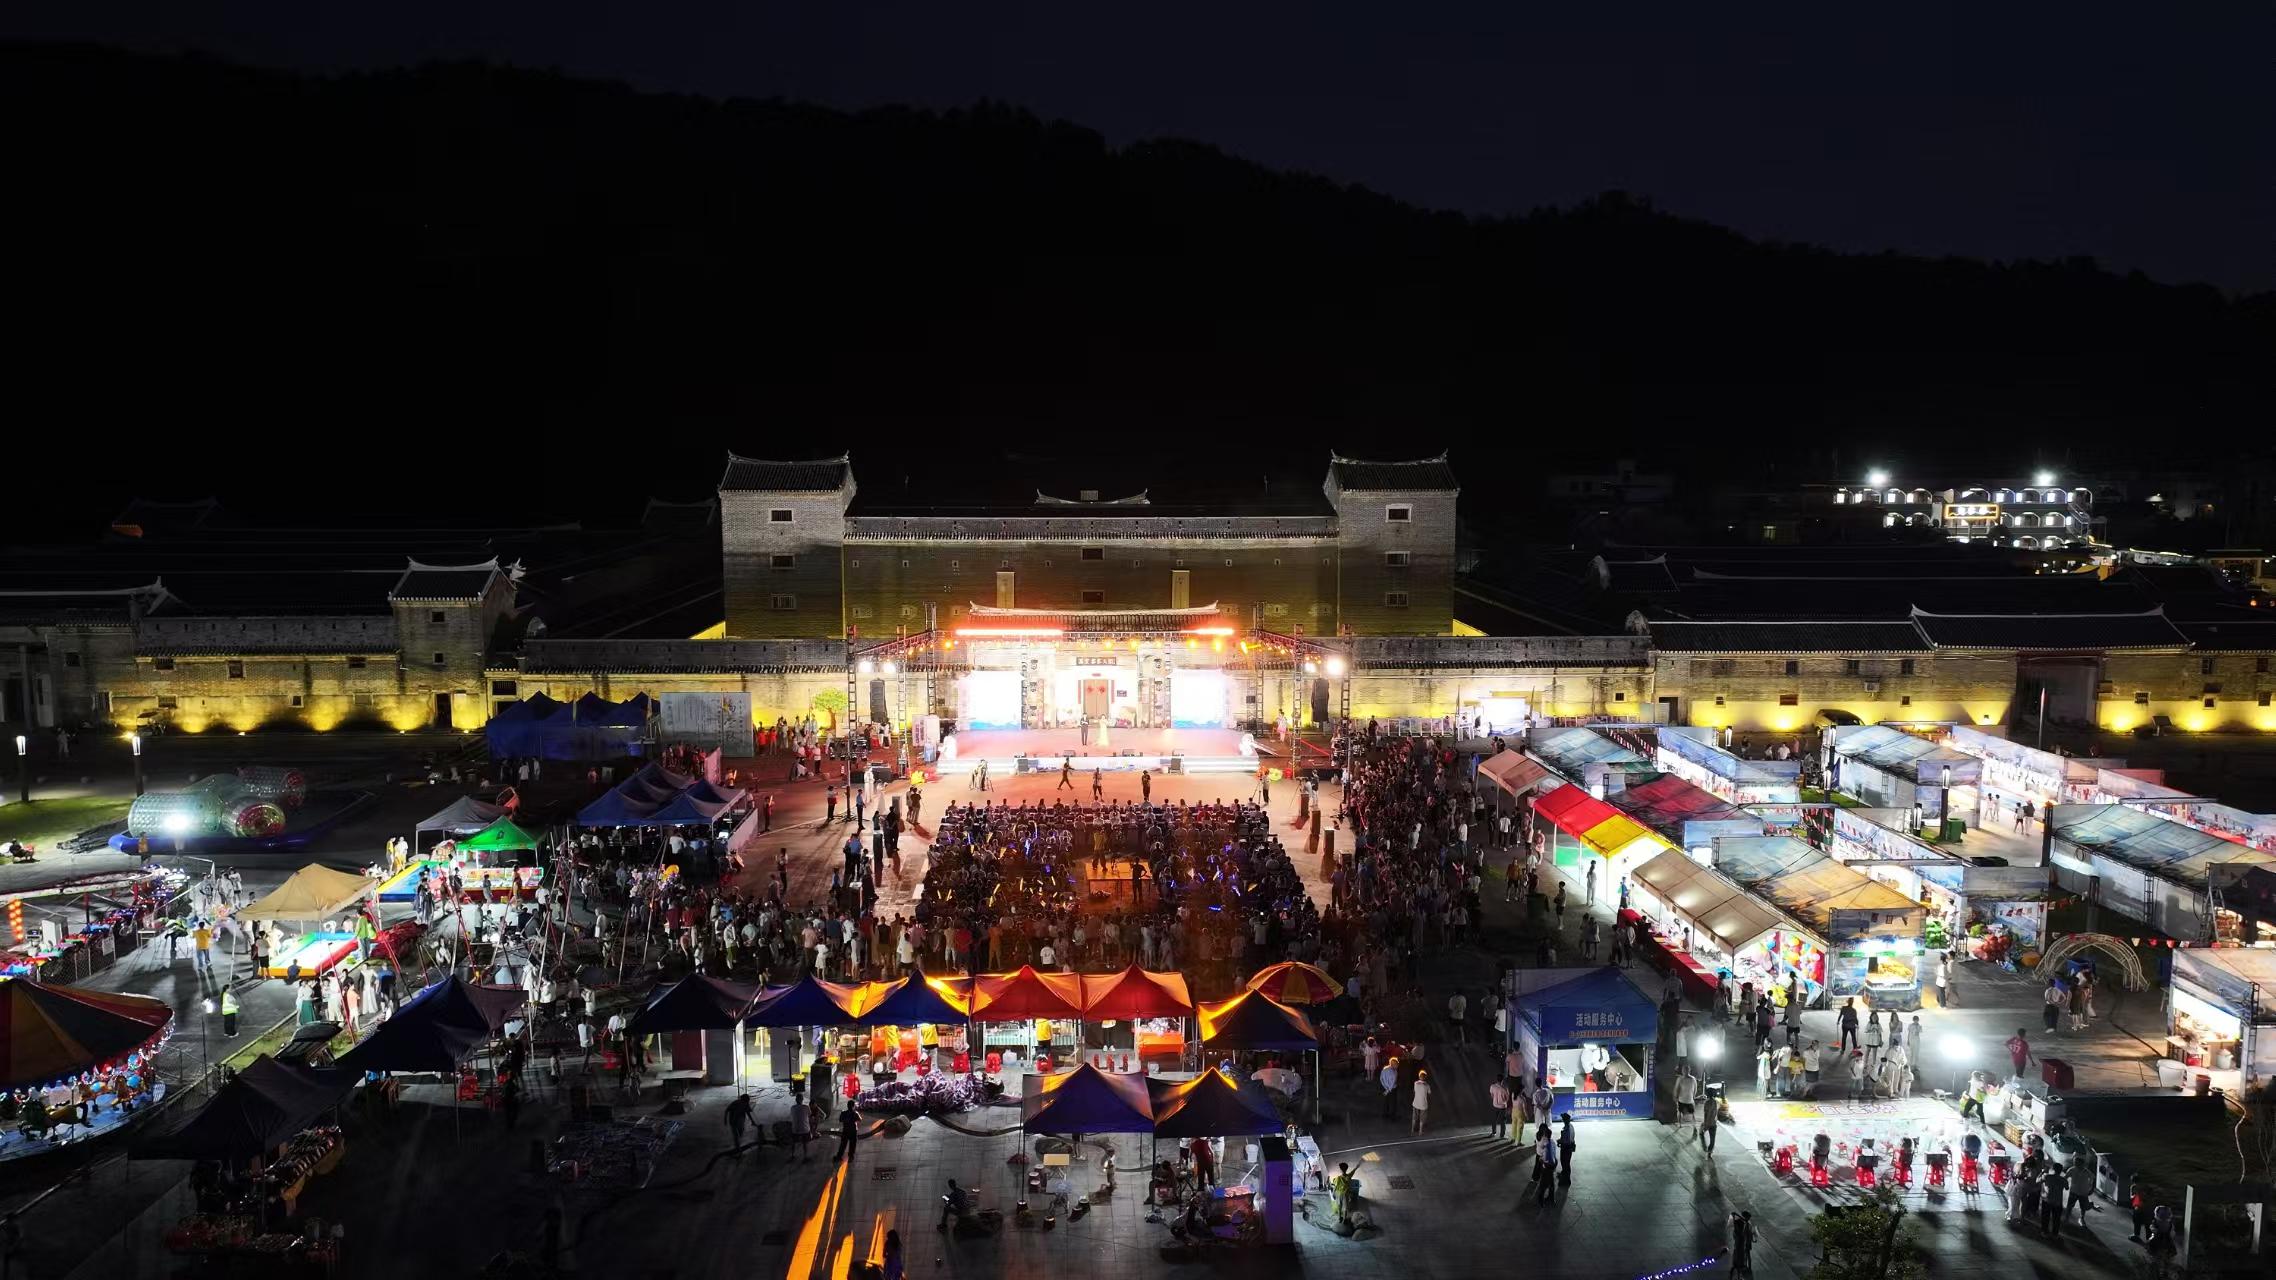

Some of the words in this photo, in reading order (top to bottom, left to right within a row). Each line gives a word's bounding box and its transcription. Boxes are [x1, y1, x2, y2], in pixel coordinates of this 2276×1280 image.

[1576, 1012, 1623, 1026] 活动服务中心
[1574, 1097, 1620, 1108] 活动服务中心
